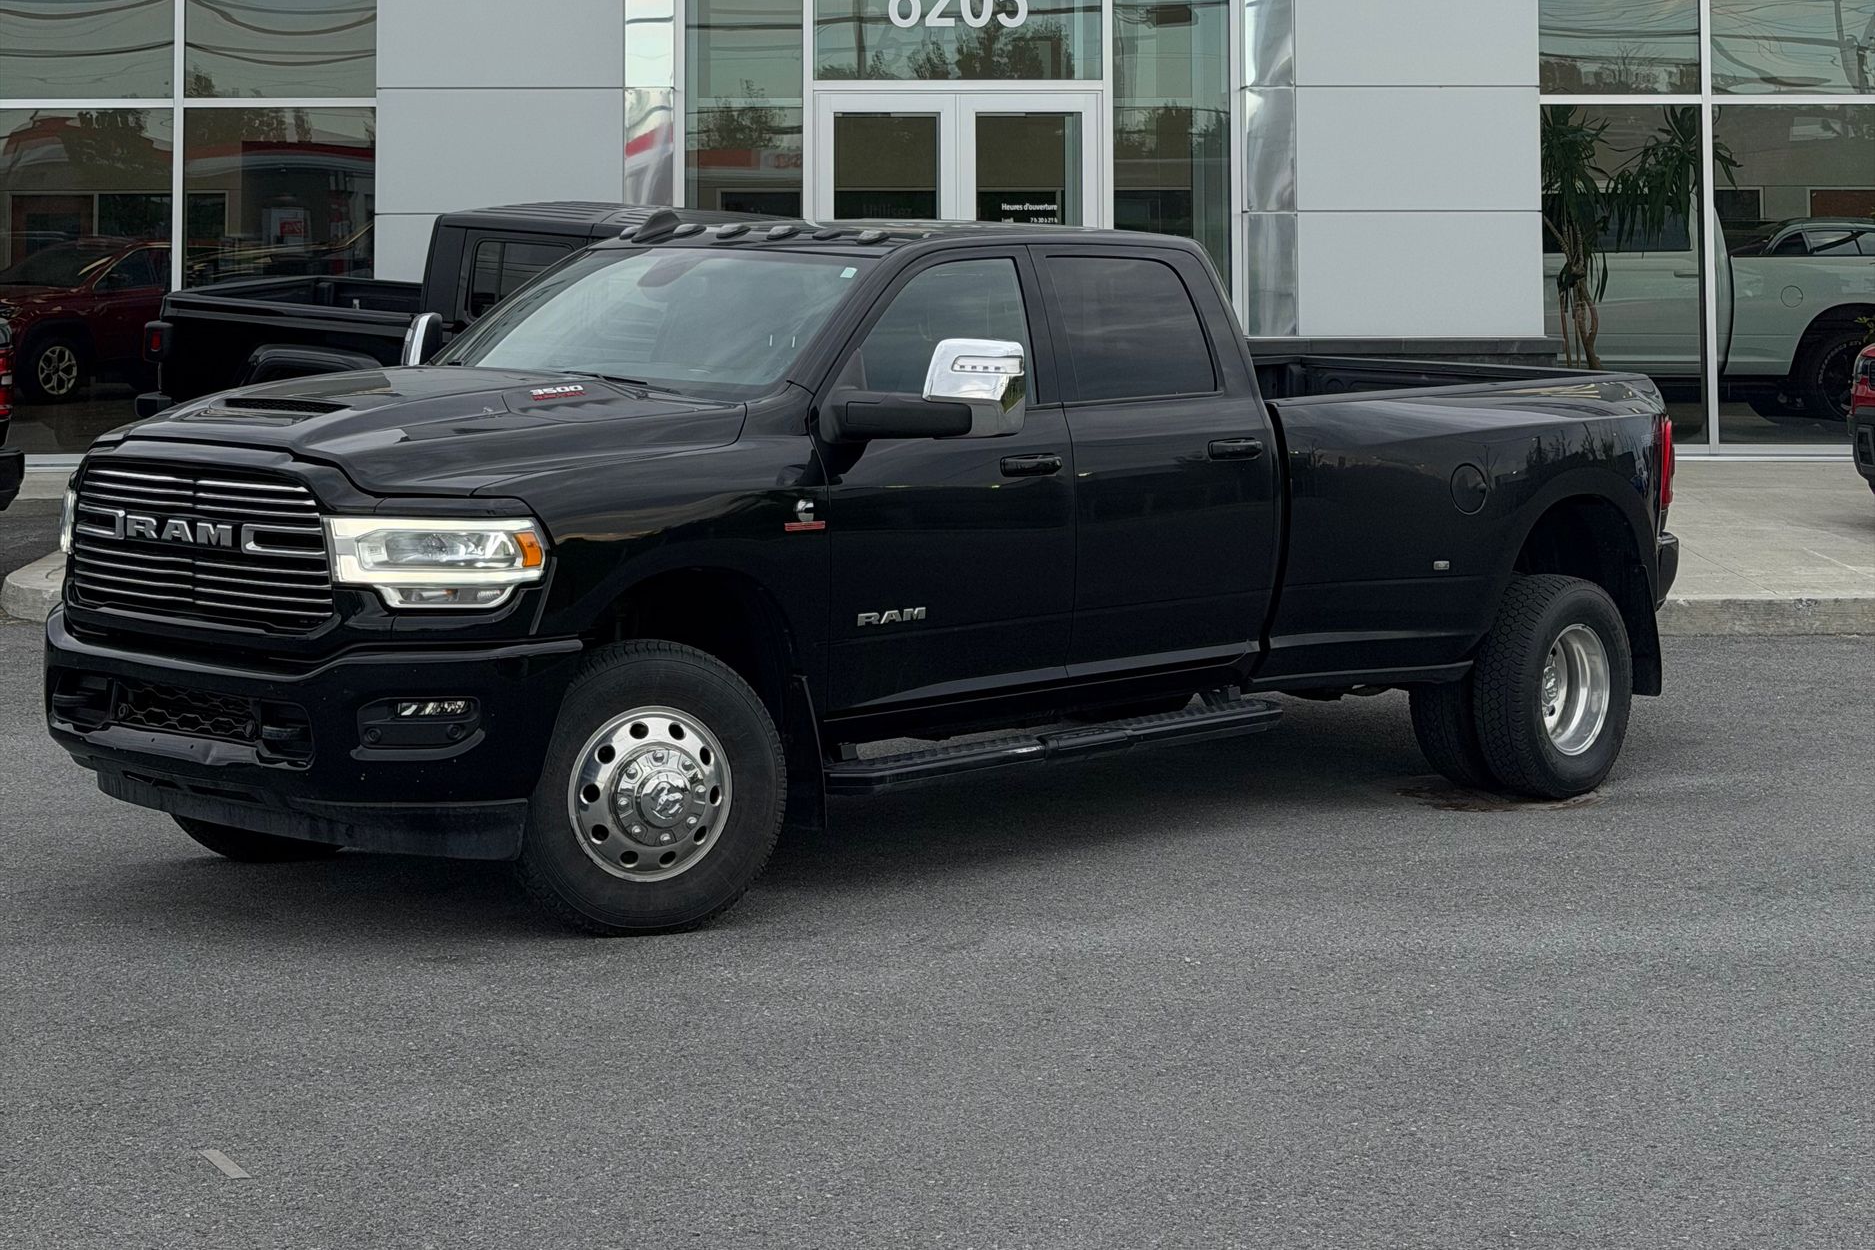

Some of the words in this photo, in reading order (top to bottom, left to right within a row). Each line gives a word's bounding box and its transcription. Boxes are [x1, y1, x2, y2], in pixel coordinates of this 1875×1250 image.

[1001, 203, 1023, 211] Heures
[1023, 203, 1058, 211] d'ouverture
[530, 385, 584, 396] 3500
[126, 515, 232, 547] RAM
[857, 606, 927, 627] RAM
